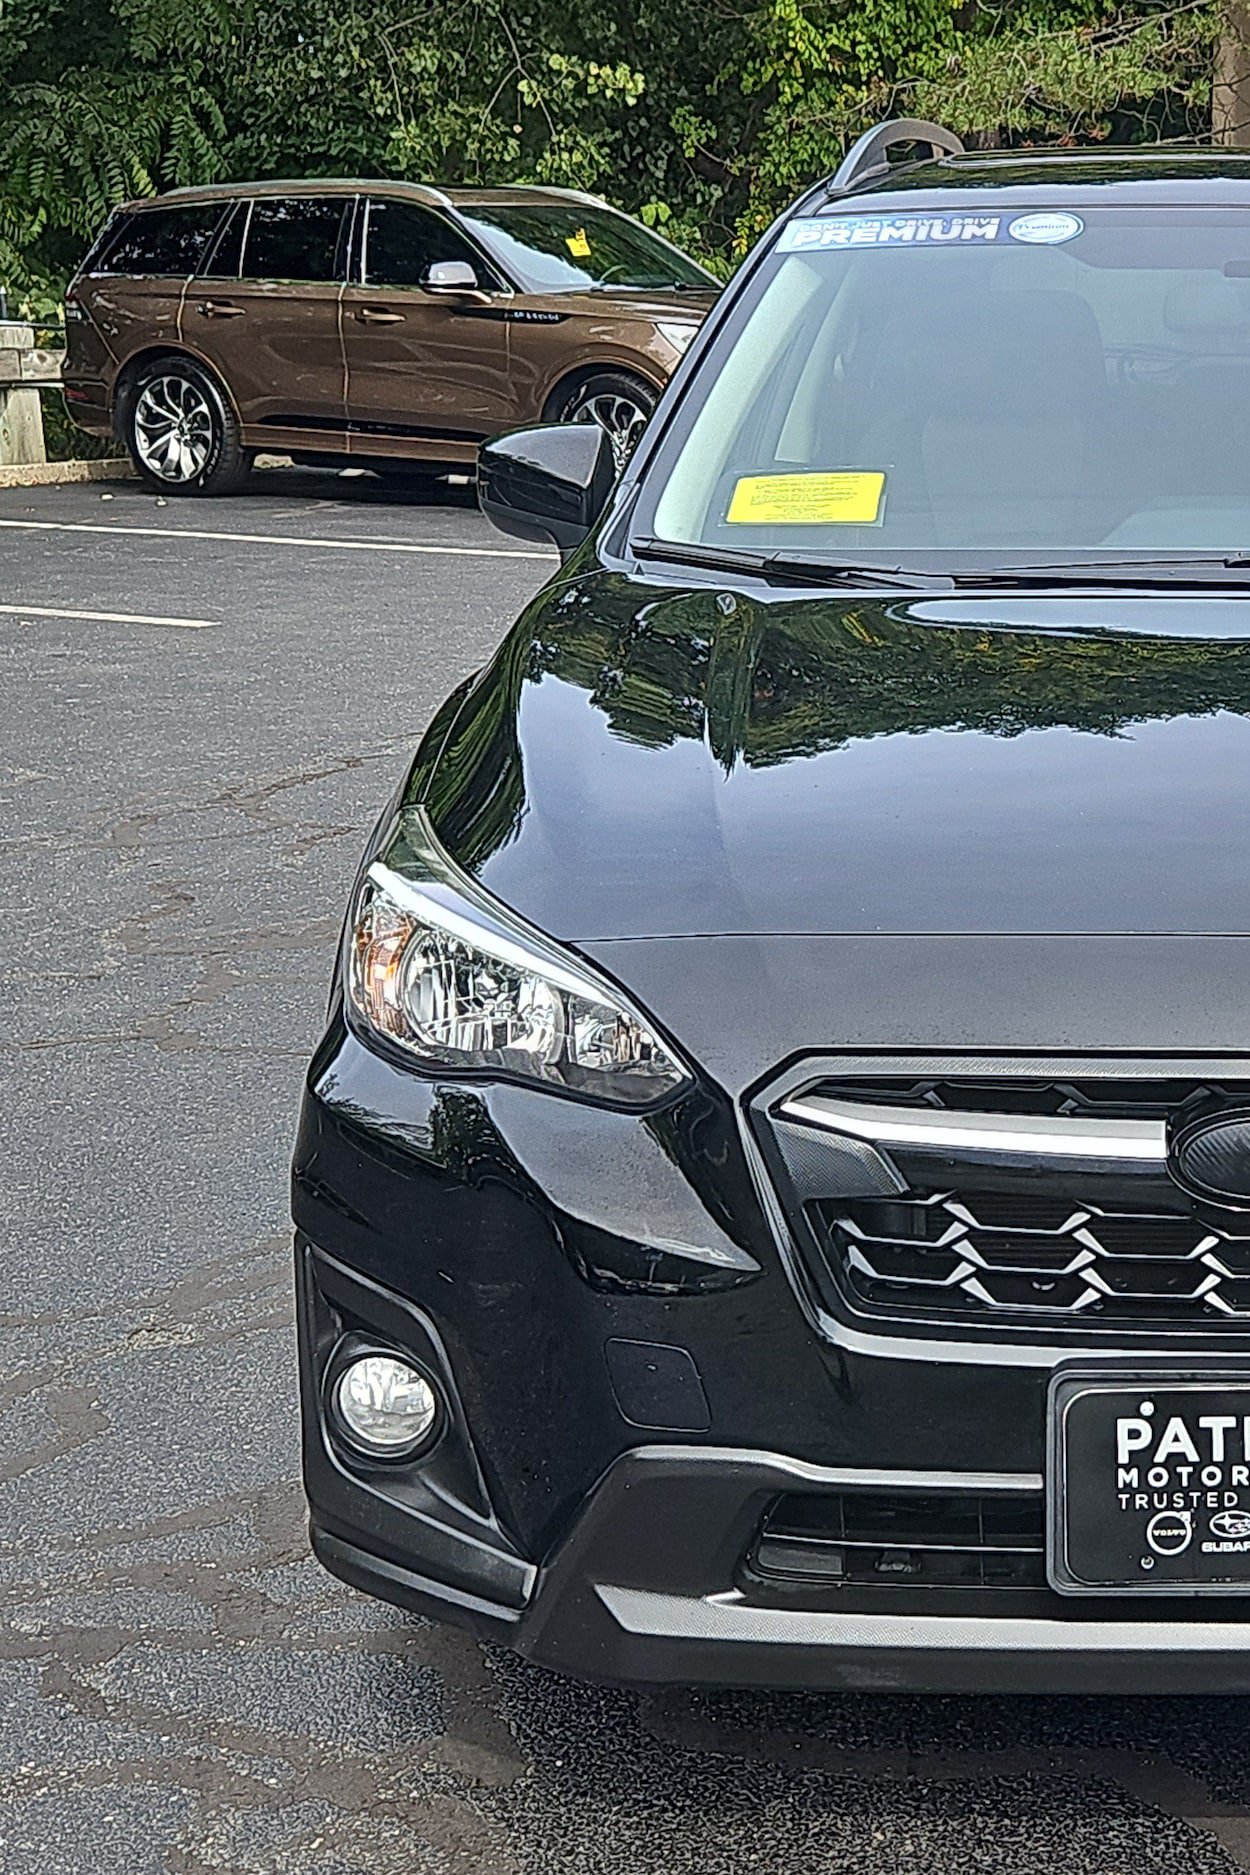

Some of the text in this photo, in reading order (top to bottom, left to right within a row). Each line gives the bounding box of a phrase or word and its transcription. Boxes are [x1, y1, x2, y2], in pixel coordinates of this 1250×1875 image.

[950, 217, 1001, 226] DRIVE
[792, 224, 999, 248] PREMIUM
[1117, 1465, 1250, 1489] MOTOR
[1117, 1491, 1239, 1510] TRUSTED
